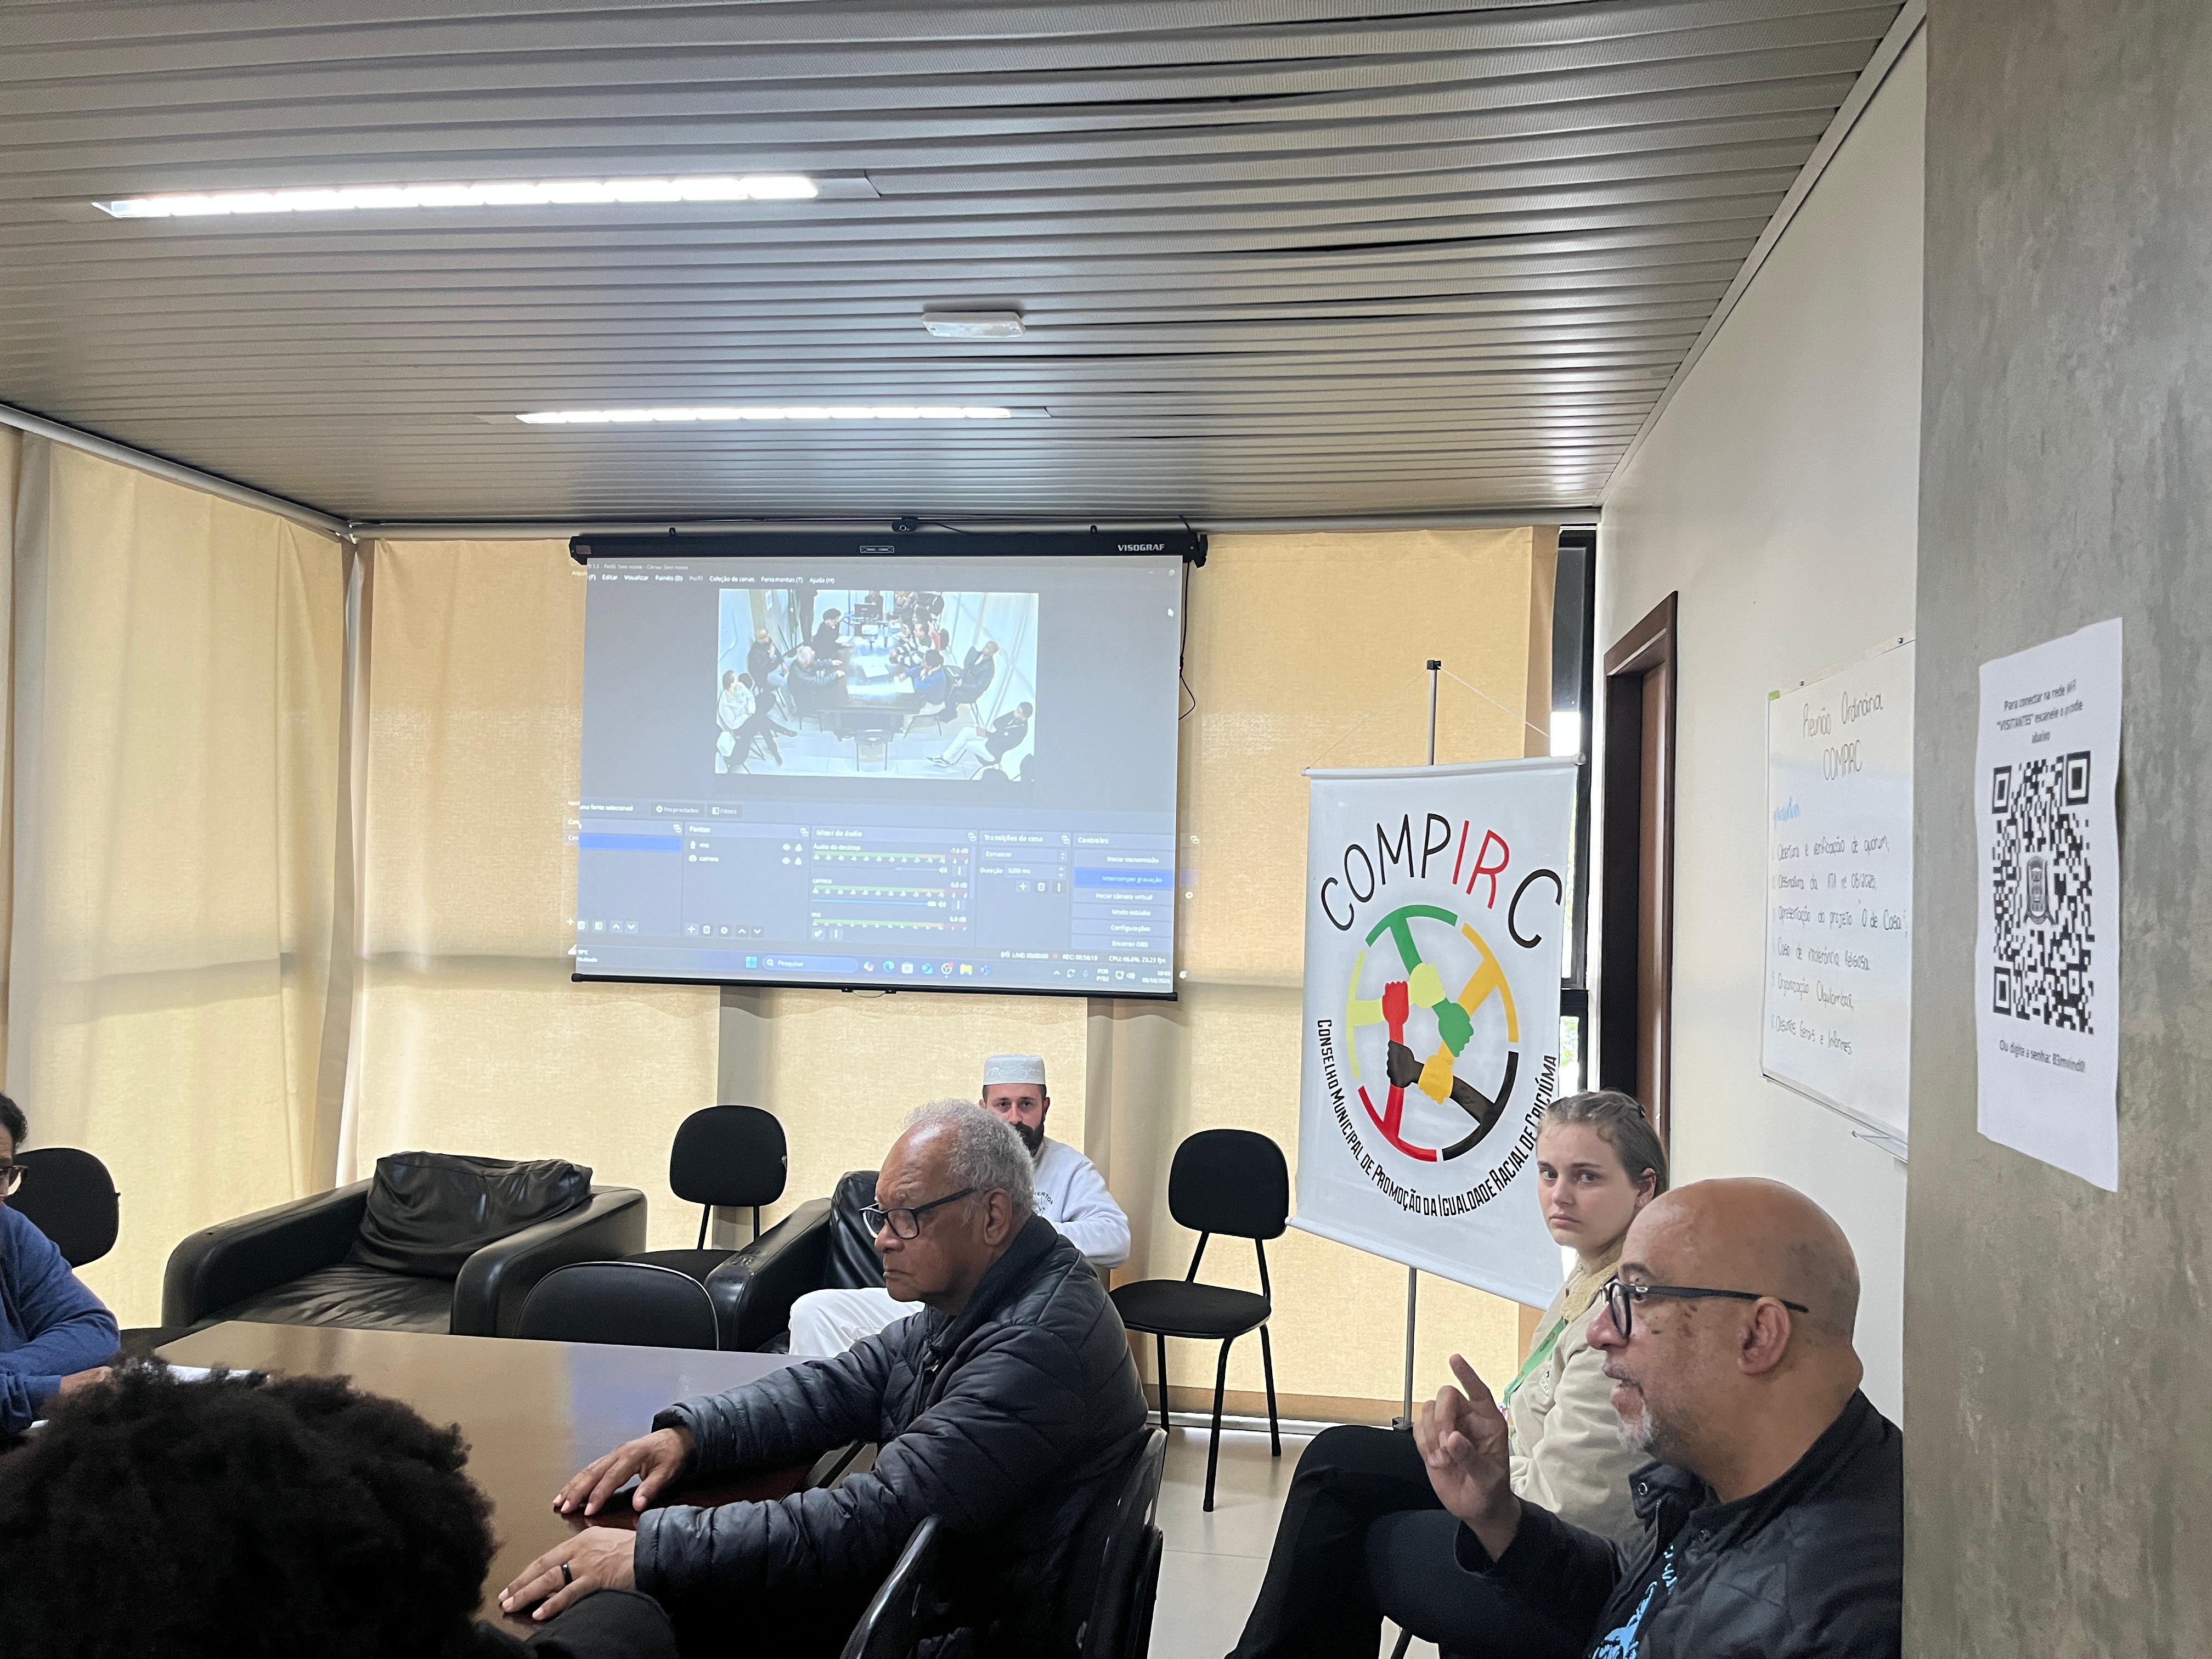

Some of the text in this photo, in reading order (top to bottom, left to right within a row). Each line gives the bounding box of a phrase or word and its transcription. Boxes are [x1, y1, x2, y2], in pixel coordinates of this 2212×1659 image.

[2004, 700, 2018, 711] Para
[2019, 693, 2042, 707] conectar
[2052, 684, 2065, 699] rede
[1803, 691, 1883, 738] Reunião Ordinária
[1851, 835, 1858, 854] de
[1320, 813, 1562, 949] COMPIRC
[1818, 910, 1825, 923] do
[1870, 911, 1878, 928] de
[1110, 924, 1150, 933] Configurações
[1796, 943, 1802, 960] de
[1820, 1034, 1824, 1045] e
[2000, 1040, 2008, 1052] Ou
[1317, 1019, 1339, 1088] CONSELHO
[1331, 1088, 1364, 1161] MUNICIPAL
[1361, 1153, 1375, 1176] DE
[1372, 1163, 1421, 1214] PROMOÇÃO
[1423, 1197, 1438, 1217] DA
[1438, 1178, 1497, 1217] IGUALDADE
[1489, 1146, 1529, 1192] RACIAL
[1519, 1126, 1537, 1152] DE
